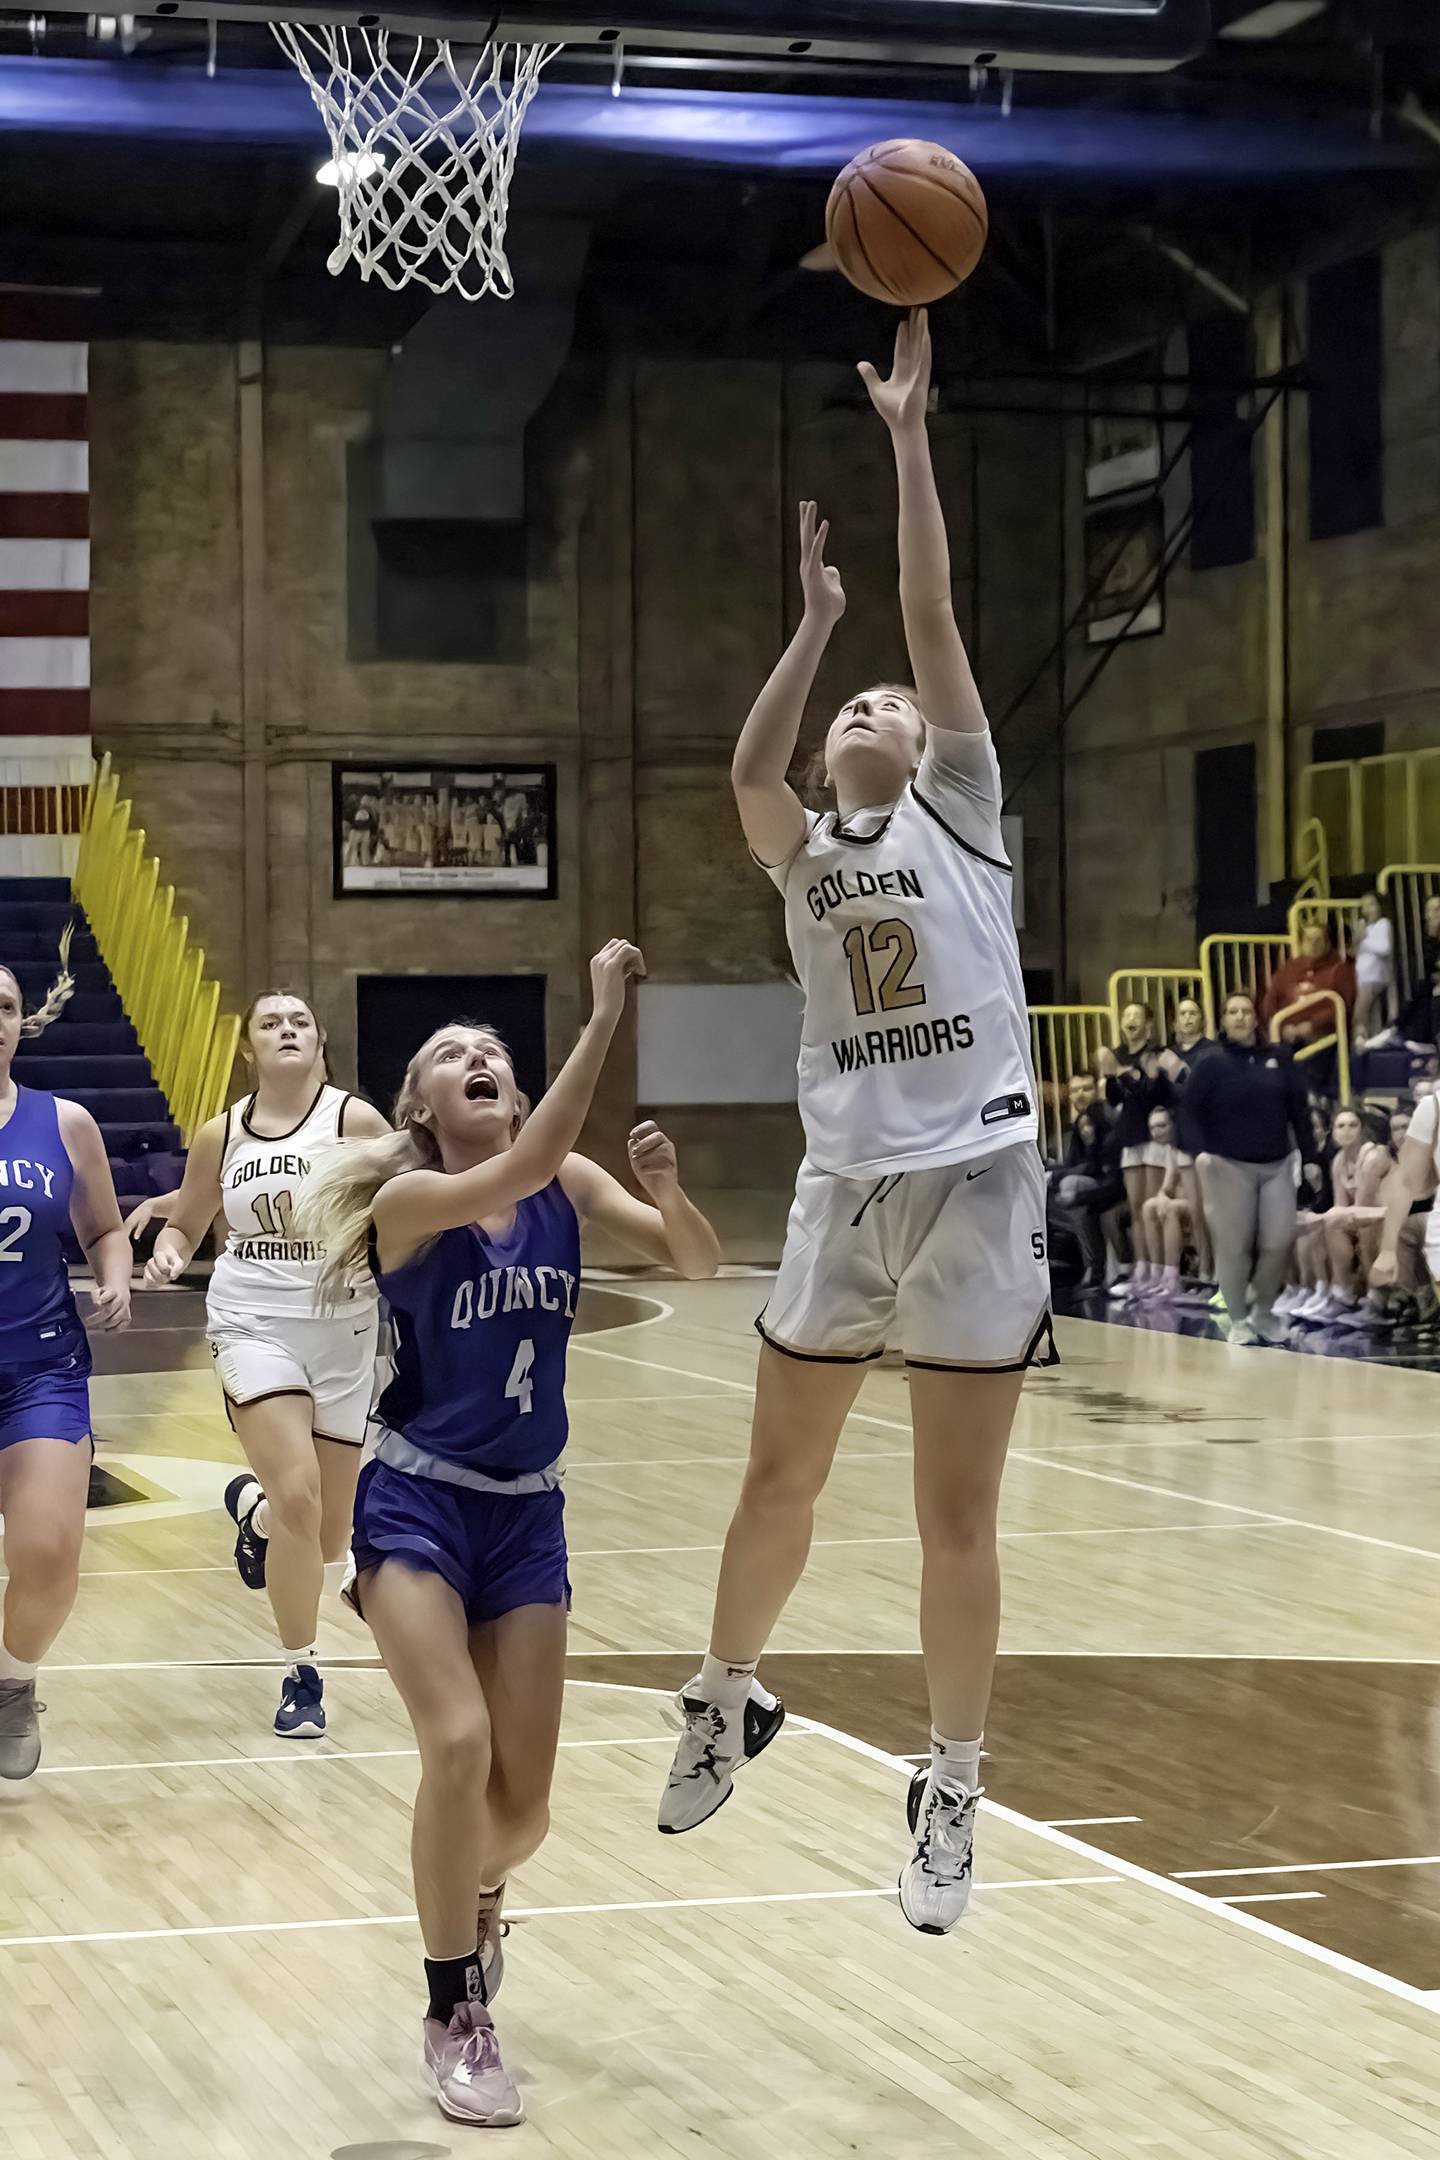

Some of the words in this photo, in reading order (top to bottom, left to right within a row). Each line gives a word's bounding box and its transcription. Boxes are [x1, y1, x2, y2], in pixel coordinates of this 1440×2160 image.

[807, 869, 925, 921] GOLDEN
[842, 917, 927, 1016] 12
[832, 1014, 974, 1074] WARRIORS
[1014, 1100, 1024, 1109] M
[251, 1189, 293, 1238] 11
[450, 1265, 576, 1330] QUINCY
[504, 1338, 536, 1415] 4
